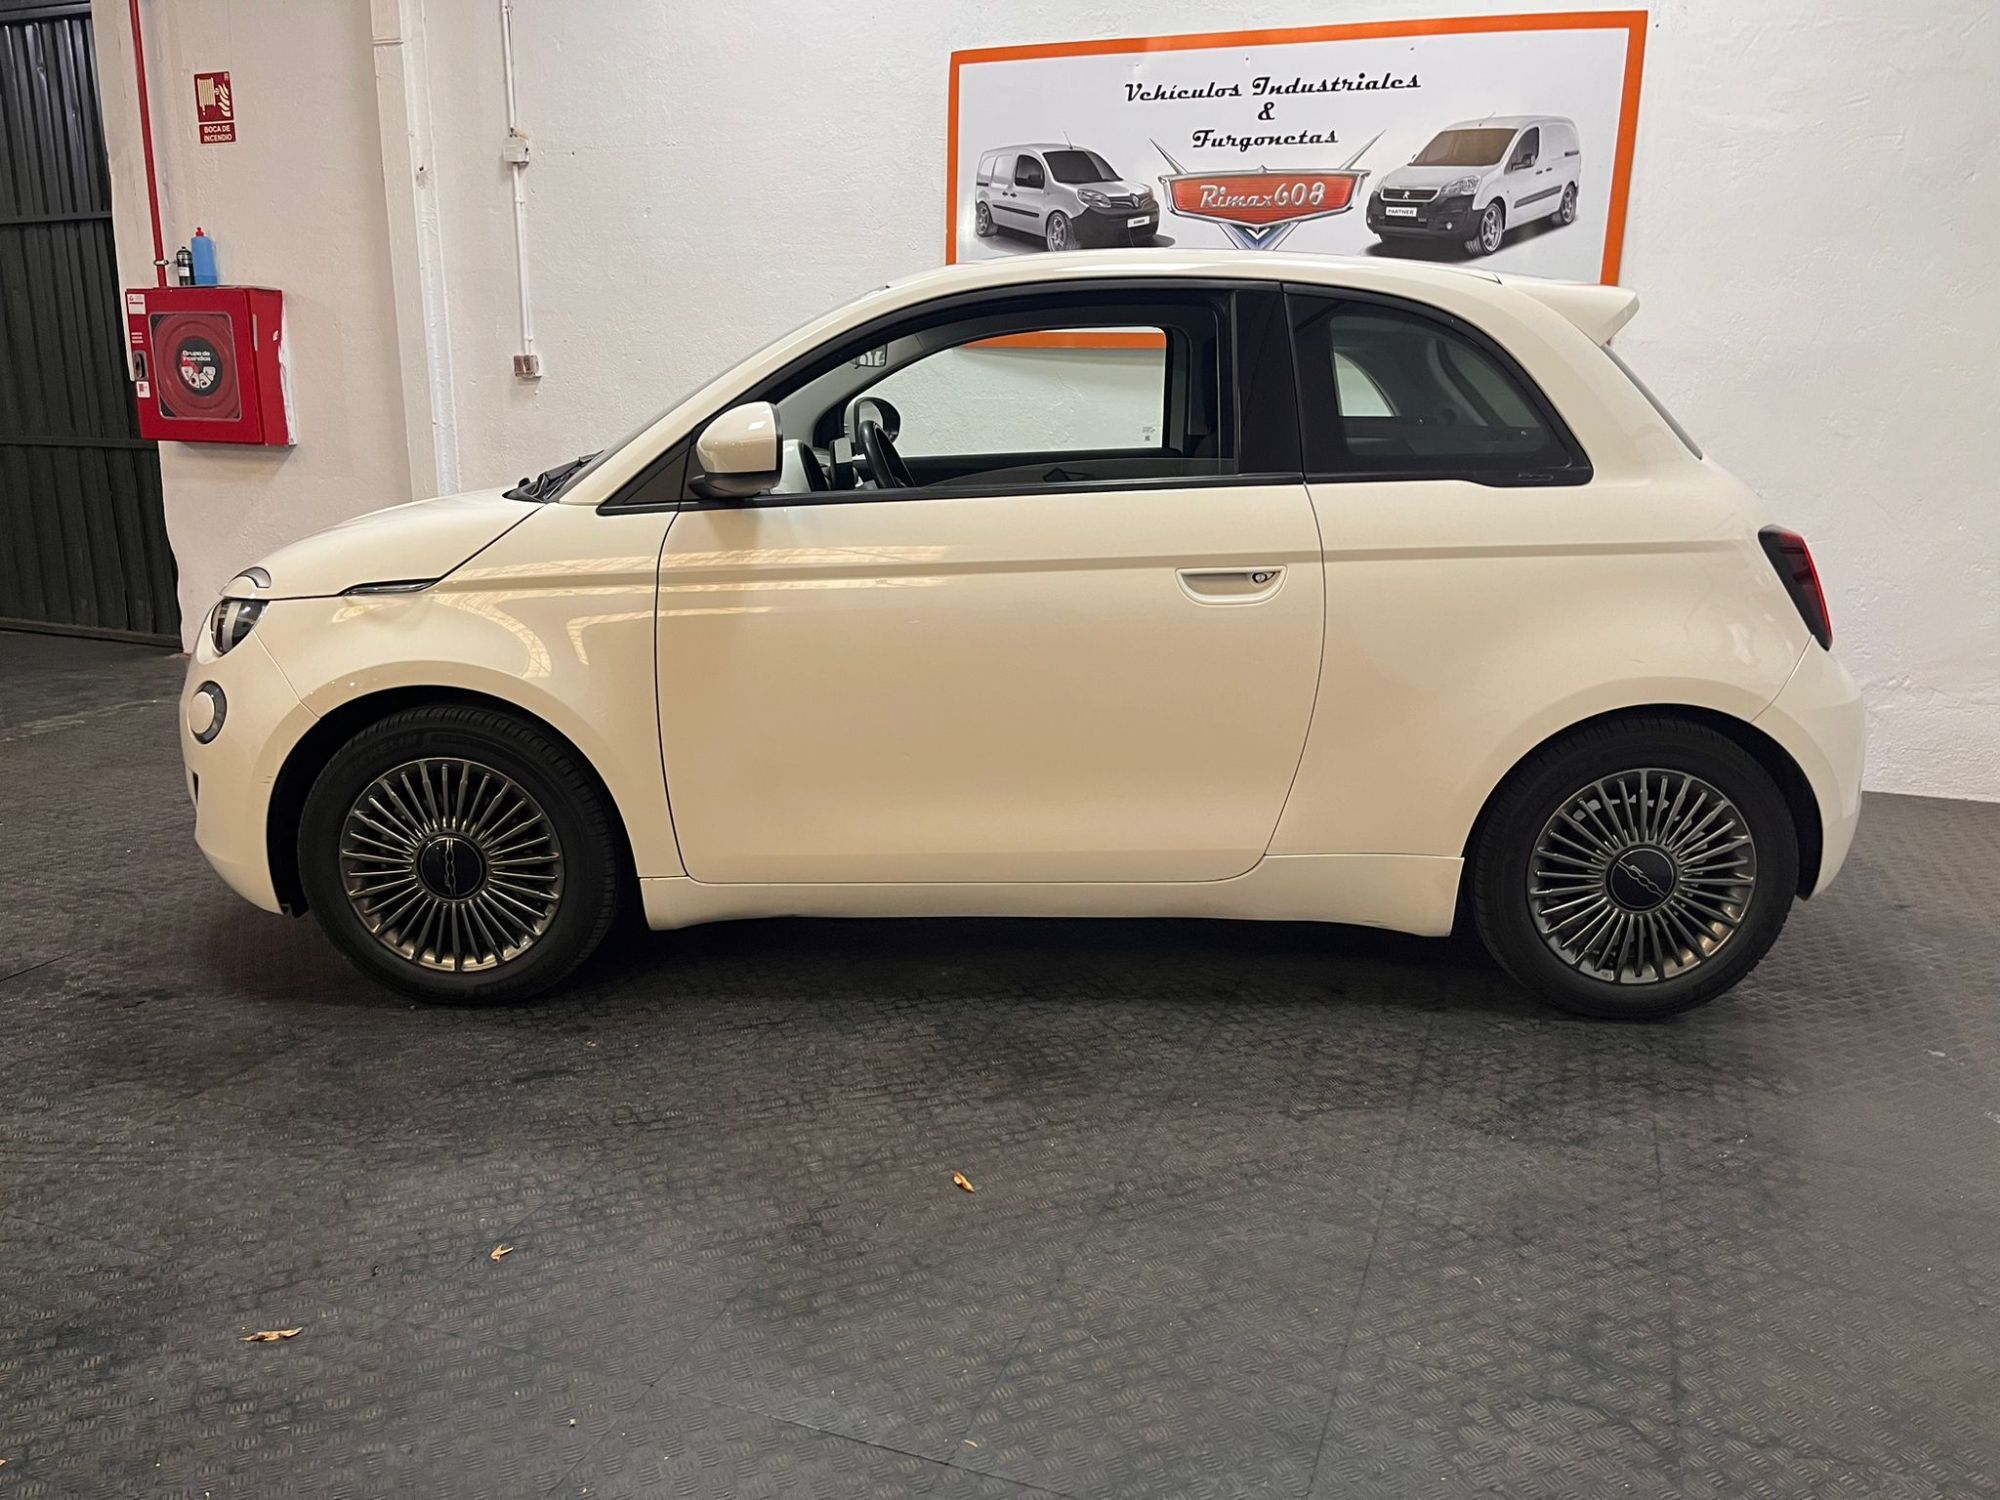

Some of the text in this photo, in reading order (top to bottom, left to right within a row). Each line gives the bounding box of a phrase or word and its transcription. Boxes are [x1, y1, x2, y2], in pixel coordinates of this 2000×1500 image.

[1125, 72, 1421, 102] Vehículos Industriales
[1257, 102, 1275, 120] &
[204, 124, 231, 133] BOCA DE
[204, 133, 232, 142] INCENDIO
[1192, 129, 1339, 152] Furgonetas
